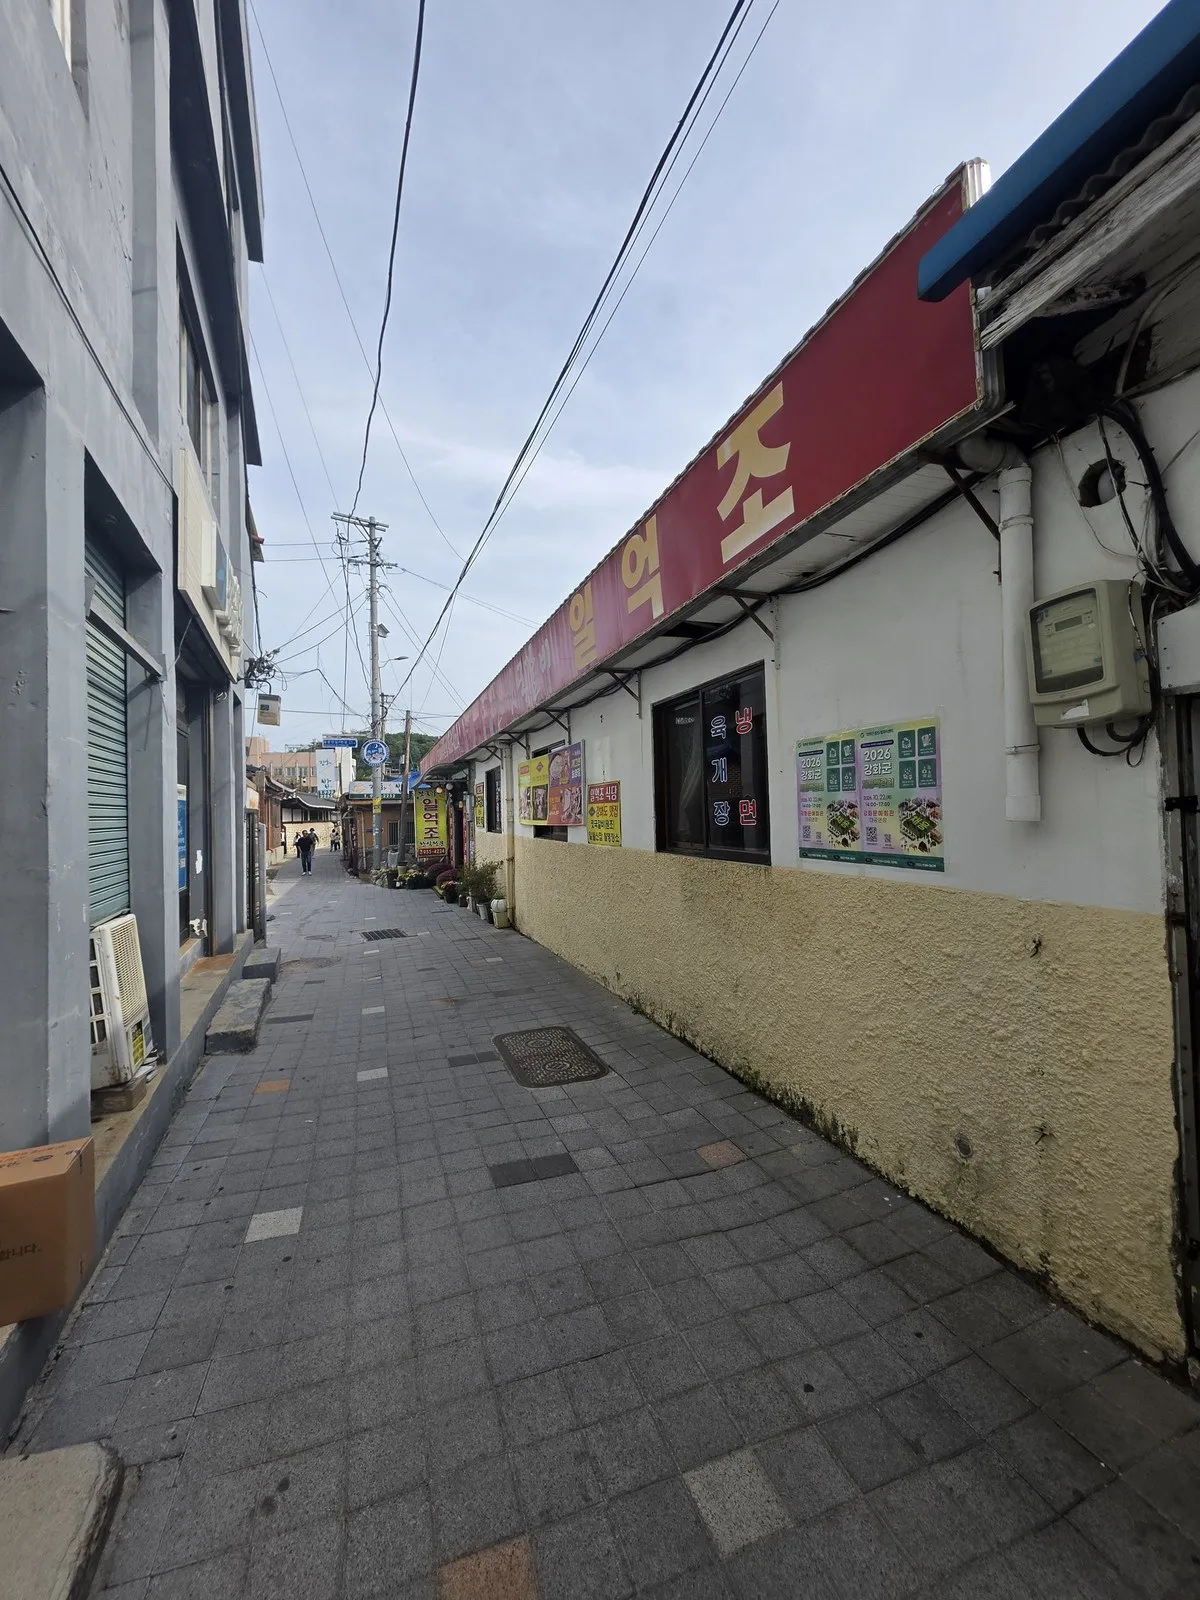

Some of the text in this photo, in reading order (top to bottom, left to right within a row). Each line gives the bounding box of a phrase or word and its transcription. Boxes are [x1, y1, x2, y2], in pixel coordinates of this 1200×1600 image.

[863, 748, 892, 762] 2026
[735, 706, 757, 826] 냉면
[801, 757, 821, 769] 2026
[863, 762, 892, 776] 강화군
[711, 714, 731, 827] 육개장
[800, 769, 822, 781] 강화군
[590, 785, 618, 803] 일억조 식당
[596, 804, 619, 818] 강화도 맛집
[422, 798, 440, 839] 일억조
